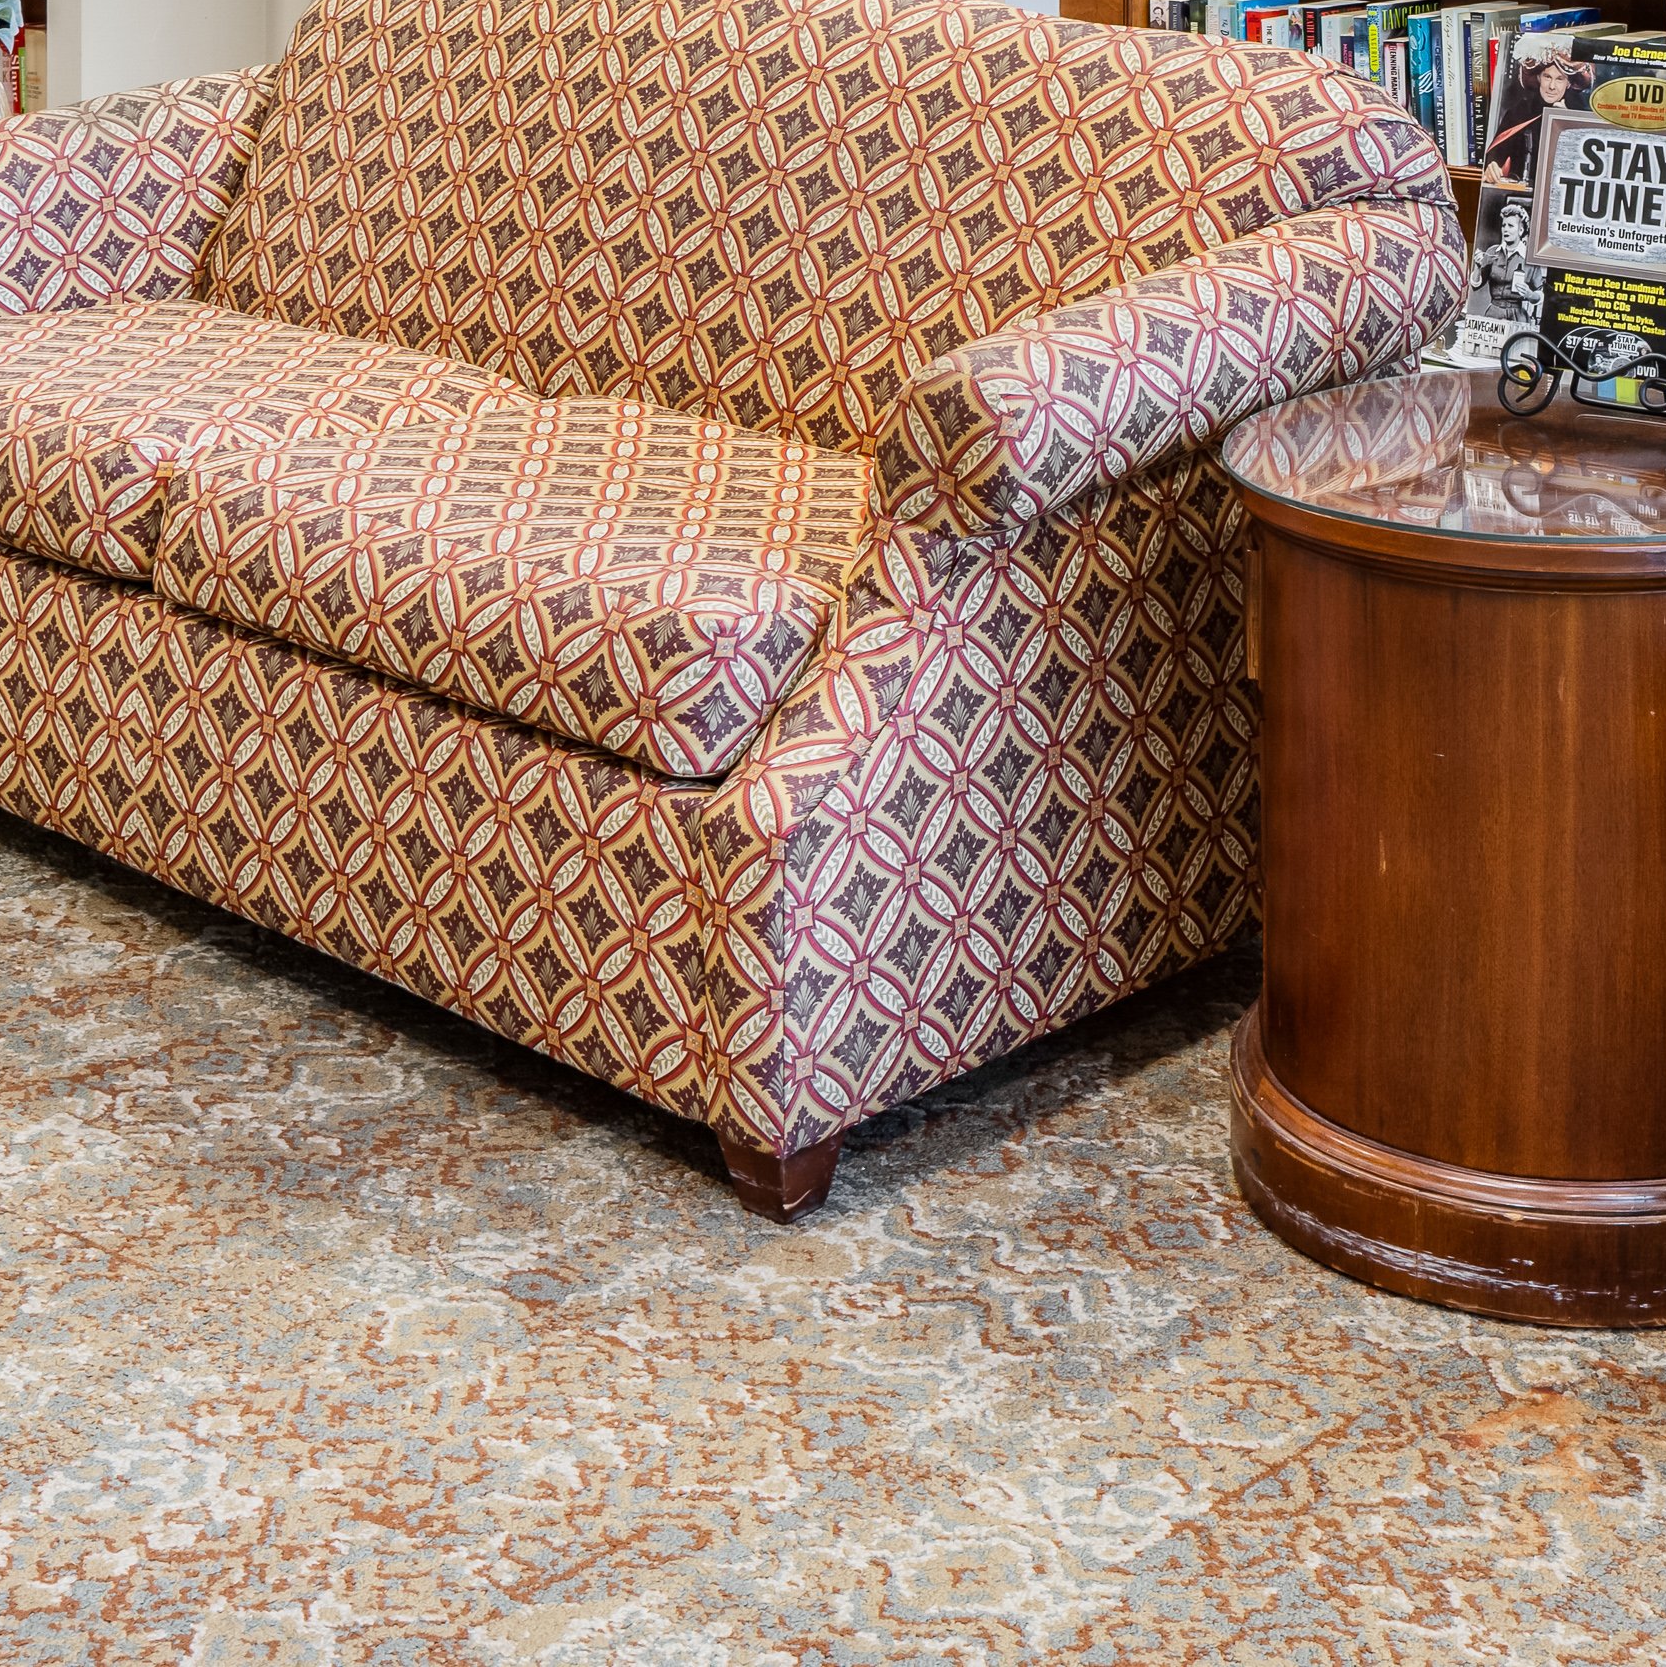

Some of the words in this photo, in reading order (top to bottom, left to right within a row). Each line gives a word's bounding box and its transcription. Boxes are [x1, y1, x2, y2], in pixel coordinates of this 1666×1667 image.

[1612, 45, 1631, 57] Joe
[1625, 83, 1664, 104] DVD
[1557, 221, 1615, 238] Television's
[1597, 238, 1645, 253] Moments
[1554, 283, 1565, 293] TV
[1567, 284, 1615, 299] Broadcasts
[1617, 292, 1628, 301] on
[1630, 294, 1635, 302] a
[1638, 293, 1655, 304] DVD
[1565, 274, 1584, 284] Hear
[1586, 276, 1603, 287] and
[1605, 279, 1621, 289] See
[1622, 281, 1665, 295] Landmark
[1594, 299, 1611, 310] Two
[1613, 301, 1631, 312] CDs
[1558, 314, 1580, 324] Walter
[1581, 317, 1611, 329] Cronkite,
[1613, 322, 1626, 330] and
[1628, 323, 1641, 332] Bob
[1642, 326, 1666, 336] Costas
[1570, 307, 1594, 316] Hosted
[1595, 310, 1603, 319] by
[1605, 311, 1620, 320] Dick
[1621, 313, 1635, 322] Van
[1636, 315, 1655, 326] Dyke,
[1468, 332, 1498, 343] HEALTH
